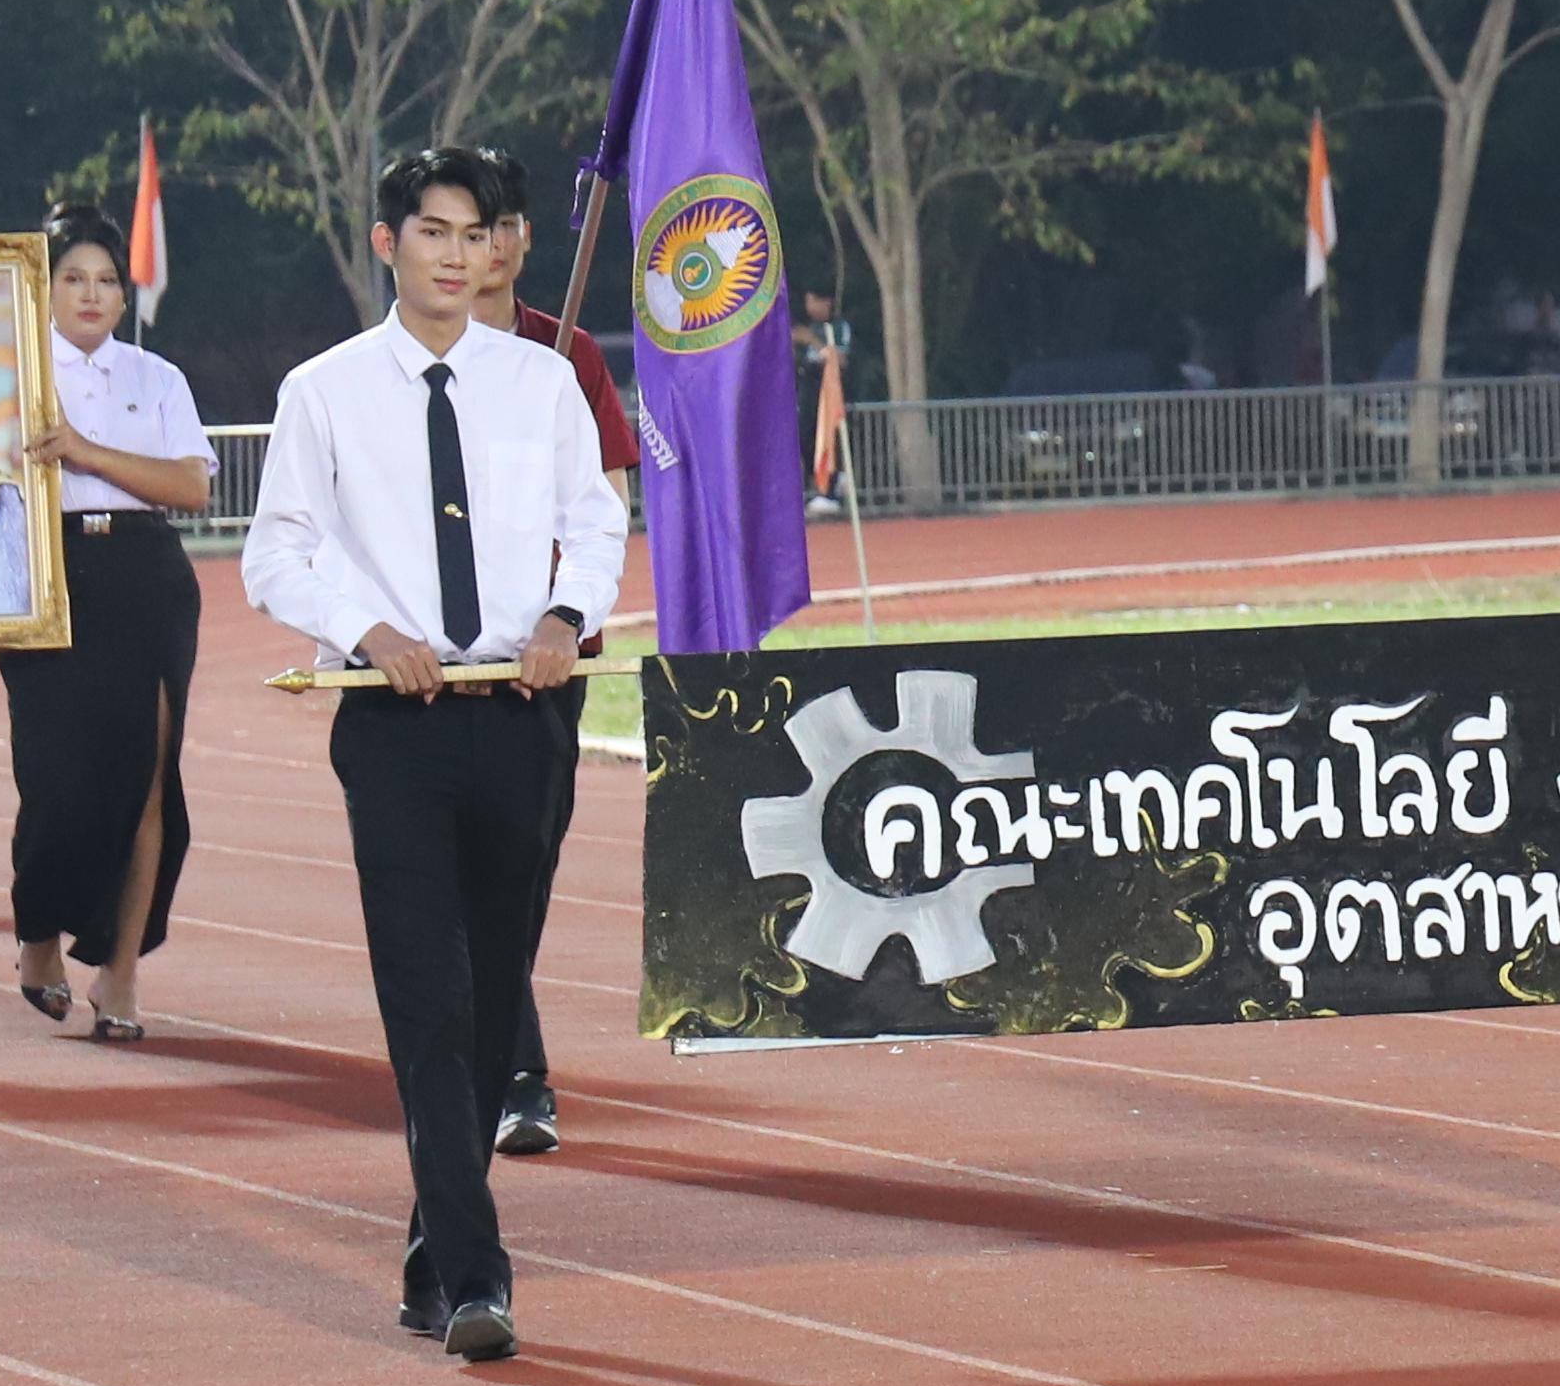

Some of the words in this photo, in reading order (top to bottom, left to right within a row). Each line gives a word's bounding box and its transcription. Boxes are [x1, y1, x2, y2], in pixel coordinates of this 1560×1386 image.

[863, 693, 1511, 880] คณะเทคโนโลยี
